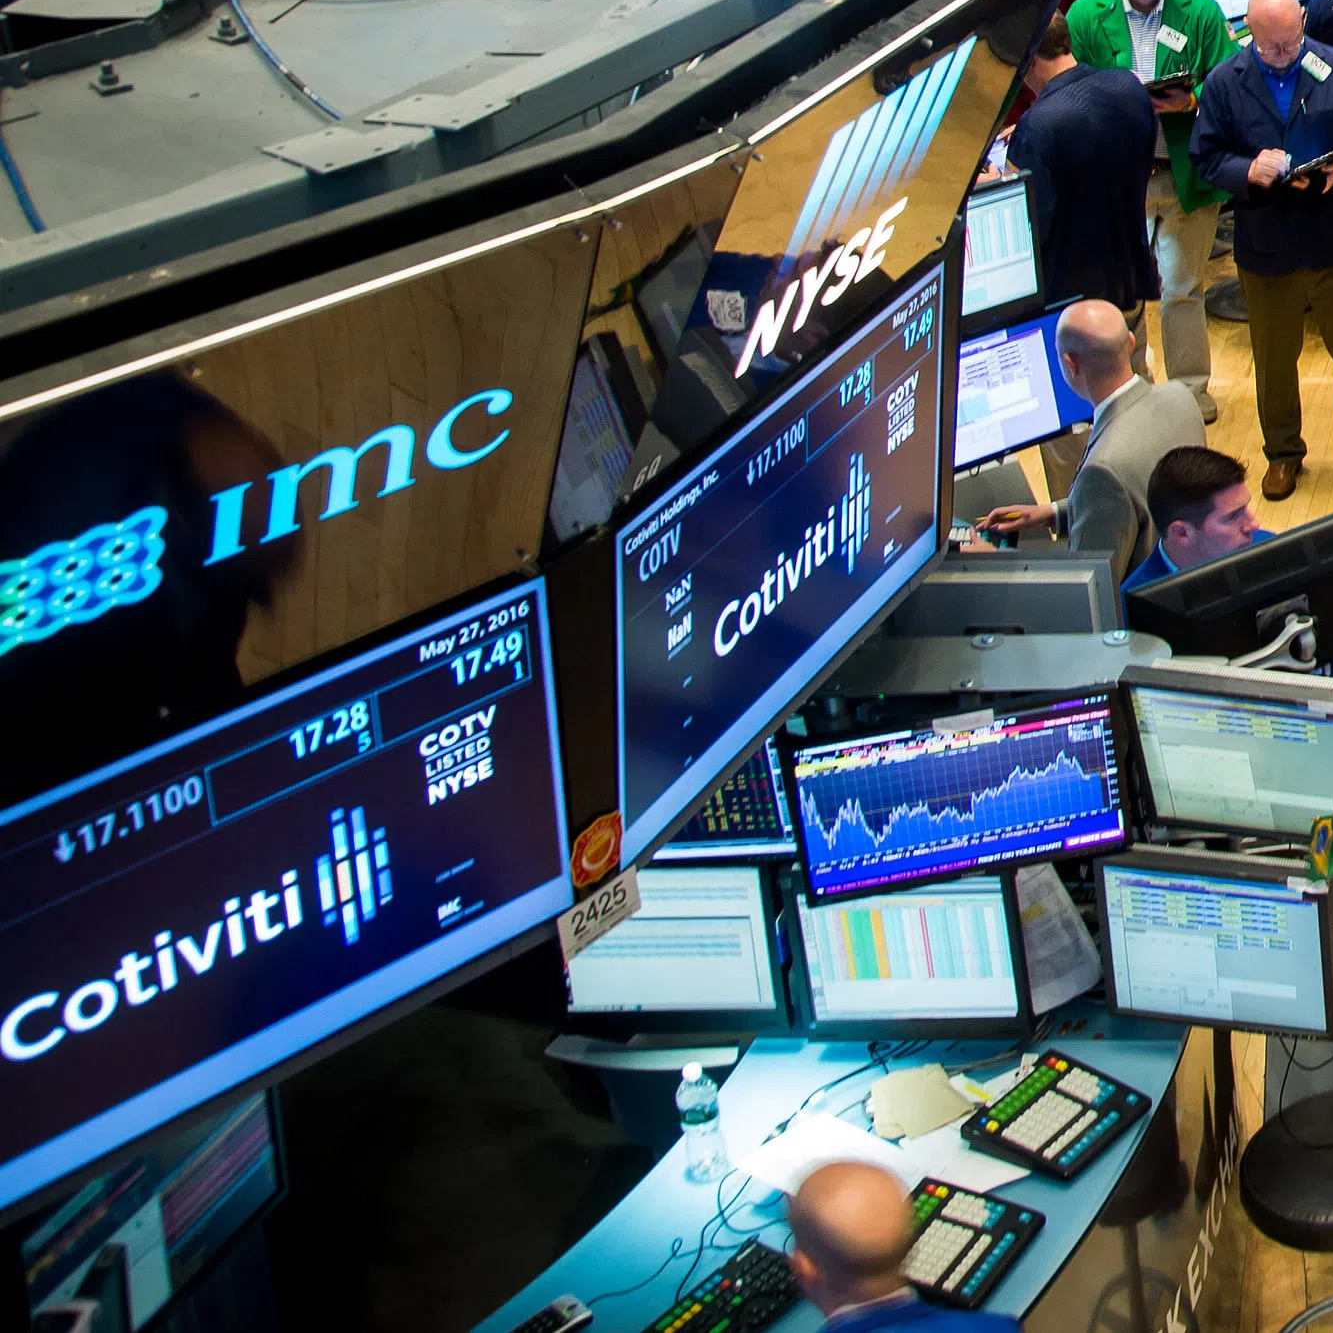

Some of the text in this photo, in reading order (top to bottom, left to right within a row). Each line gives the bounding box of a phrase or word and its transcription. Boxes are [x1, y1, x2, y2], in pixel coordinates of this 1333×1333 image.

[734, 196, 909, 379] NYSE
[891, 308, 909, 330] May
[886, 370, 919, 412] COTV
[639, 306, 933, 582] COTV 17.1100 17.28 17.49
[887, 416, 915, 456] NYSE
[203, 387, 513, 567] imc
[625, 469, 719, 555] Cotiviti Holdings, Inc.
[665, 573, 692, 613] NaN
[713, 505, 836, 658] Cotiviti
[418, 602, 530, 662] May 27, 2016
[666, 610, 693, 652] NaN
[78, 631, 524, 852] 17.1100 17.28 17.49
[357, 731, 372, 753] 5
[418, 704, 496, 758] COTV
[424, 736, 492, 778] LISTED
[428, 756, 494, 806] NYSE
[571, 882, 627, 936] 2425
[0, 868, 303, 1062] Cotiviti
